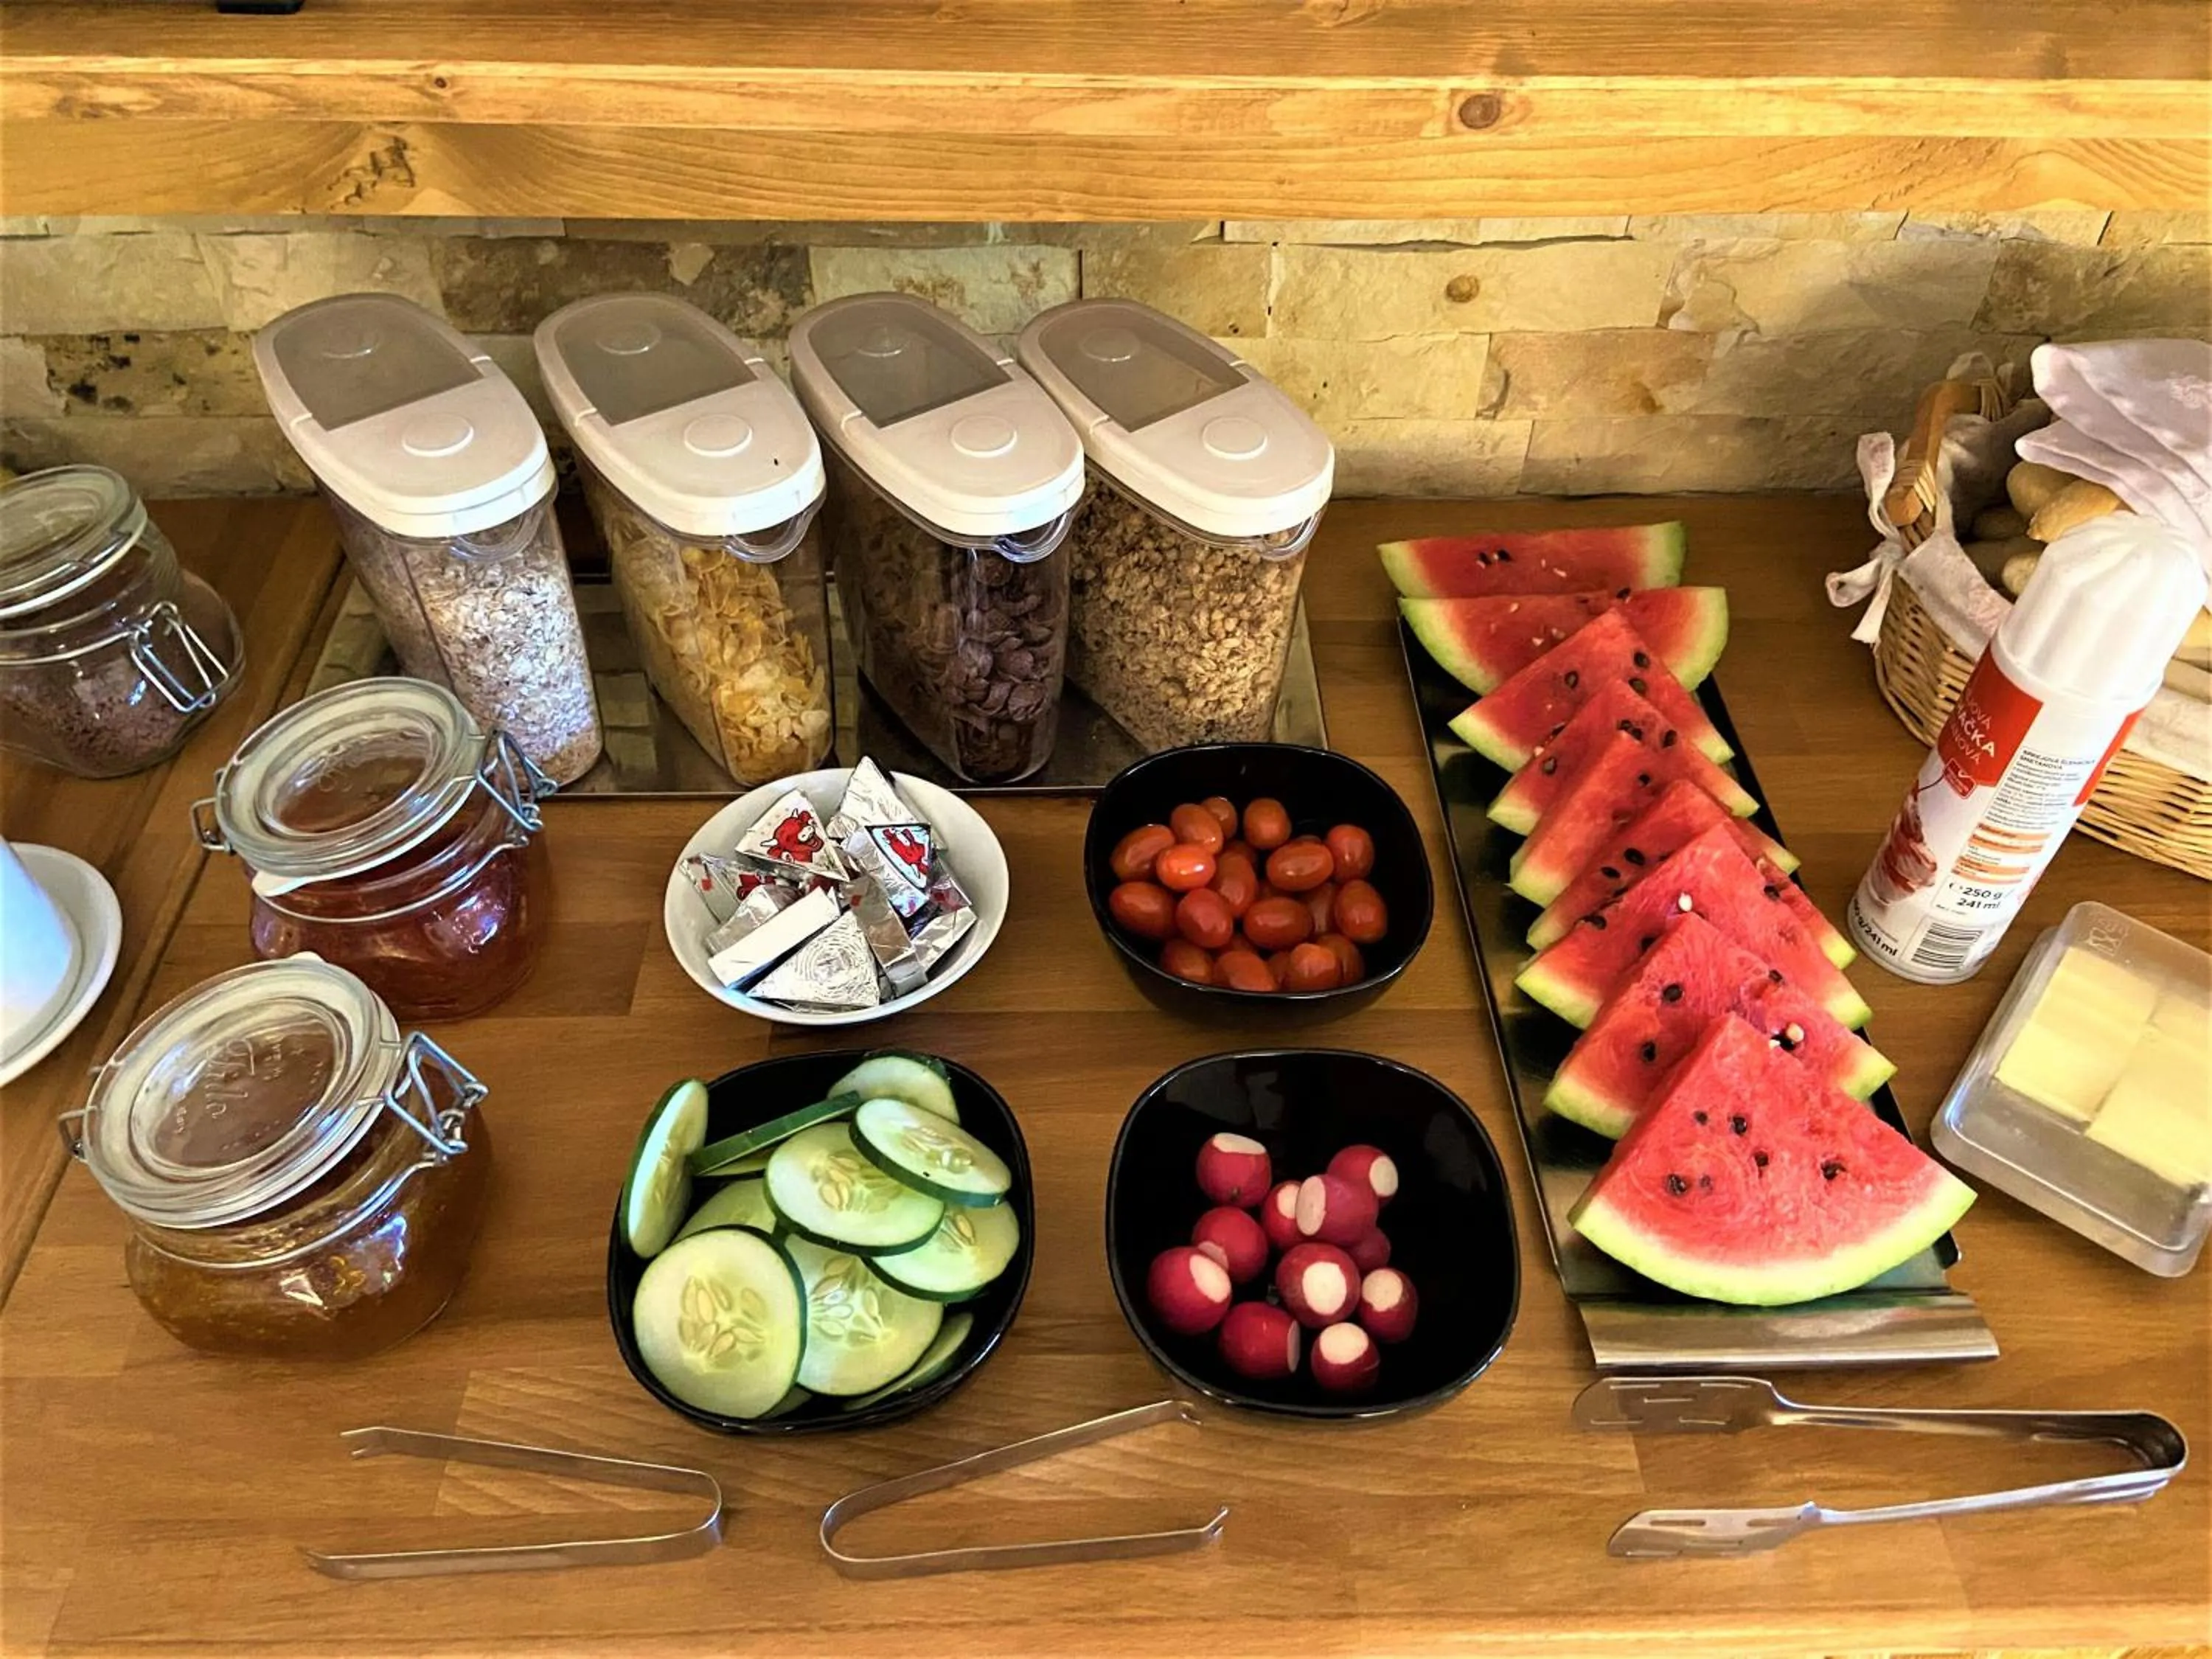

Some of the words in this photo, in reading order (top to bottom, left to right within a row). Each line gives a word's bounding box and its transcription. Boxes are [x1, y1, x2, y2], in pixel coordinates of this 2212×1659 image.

[1963, 887, 1991, 898] 250
[1993, 892, 2003, 900] g
[1958, 897, 1982, 909] 241
[1881, 943, 1898, 956] ml
